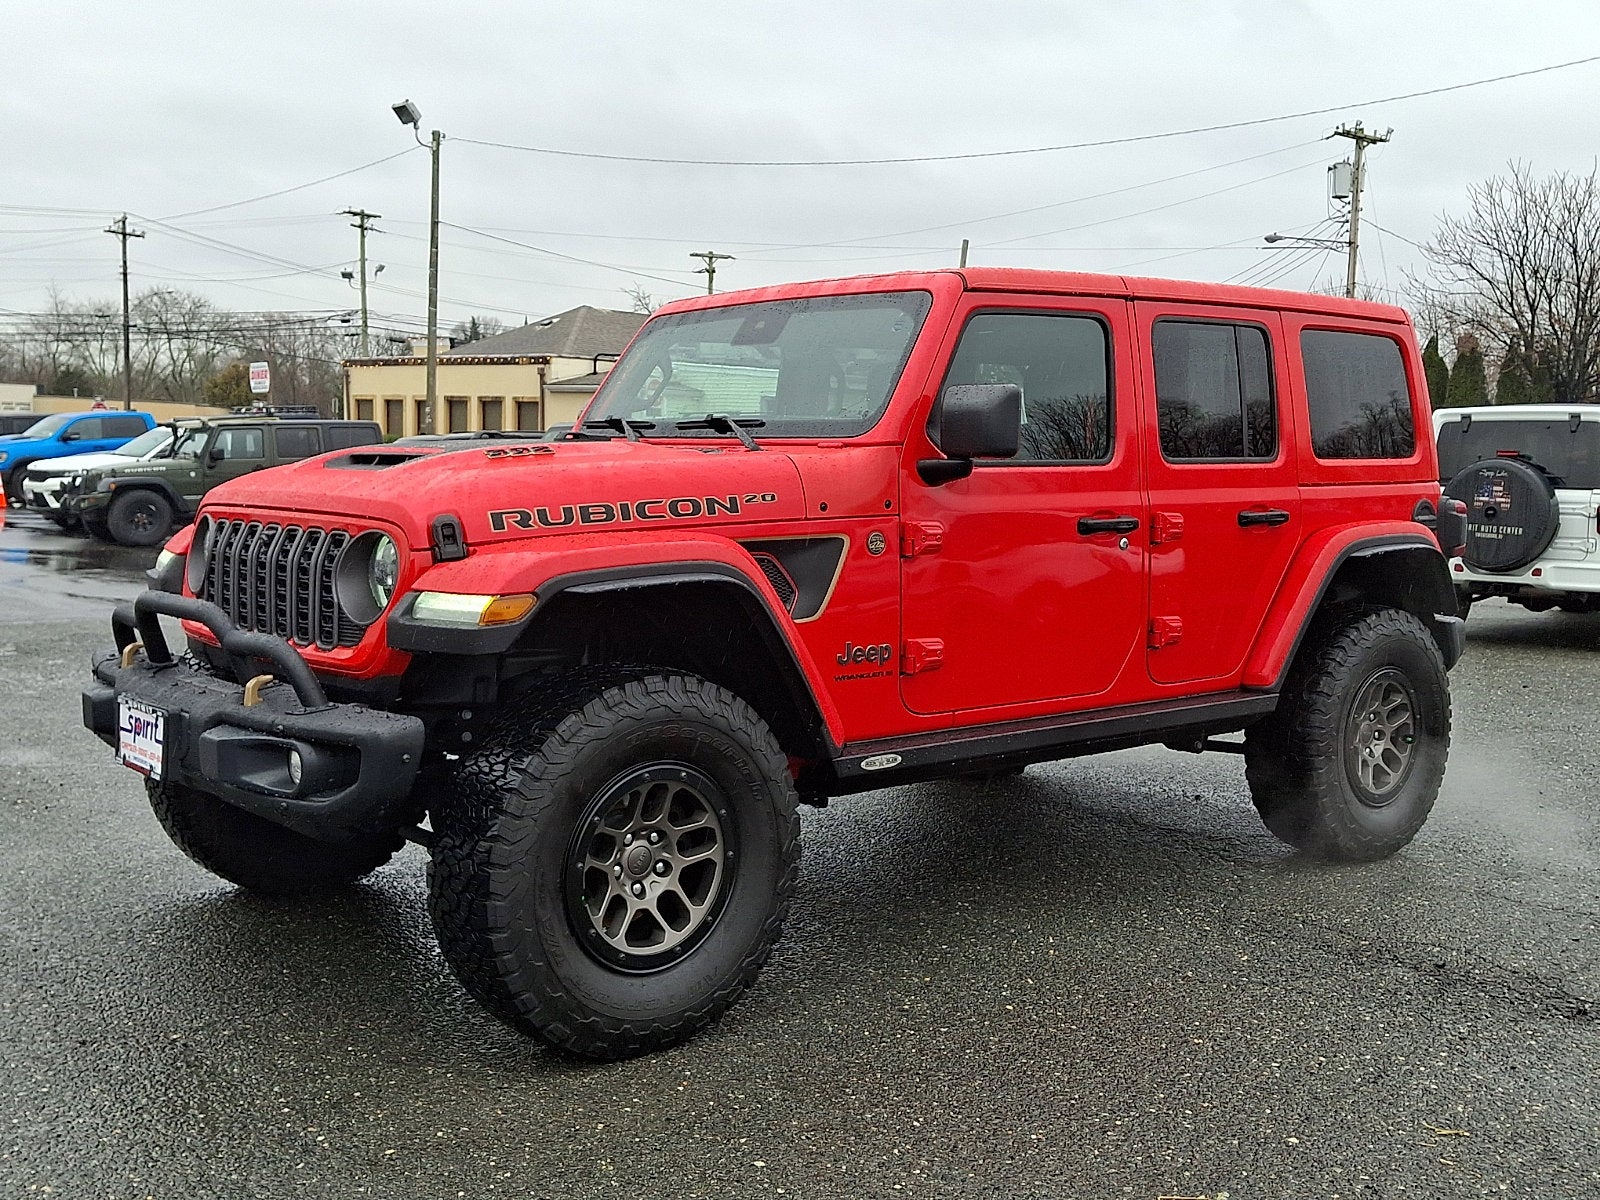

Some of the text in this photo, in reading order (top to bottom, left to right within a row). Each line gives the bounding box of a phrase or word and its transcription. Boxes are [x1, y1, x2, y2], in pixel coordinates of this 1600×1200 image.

[251, 369, 268, 380] DINER
[483, 445, 555, 459] 392
[488, 492, 777, 532] RUBICON 20
[1481, 524, 1498, 533] AUTO
[1499, 526, 1523, 535] CENTER
[836, 641, 893, 666] Jeep
